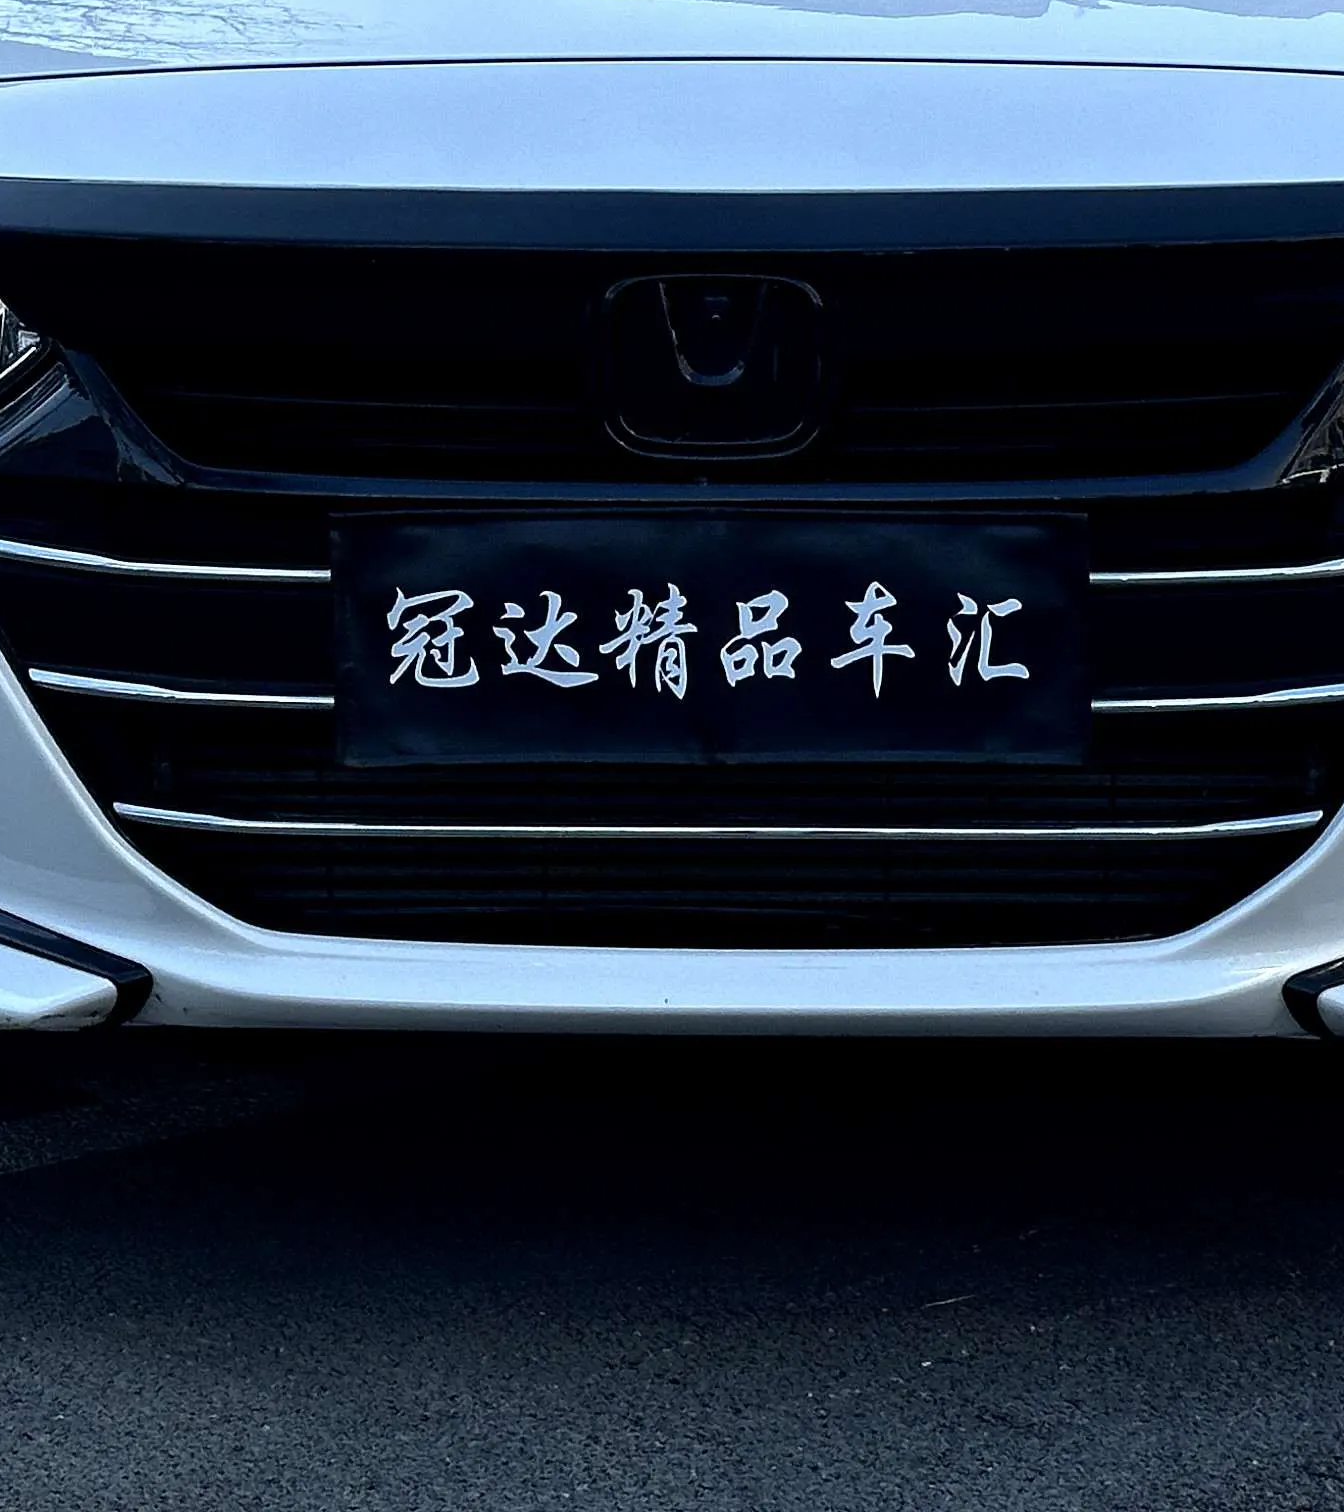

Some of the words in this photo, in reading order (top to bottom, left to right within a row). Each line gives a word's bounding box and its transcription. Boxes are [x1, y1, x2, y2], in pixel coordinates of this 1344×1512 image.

[387, 580, 1030, 700] 冠达精品车汇
